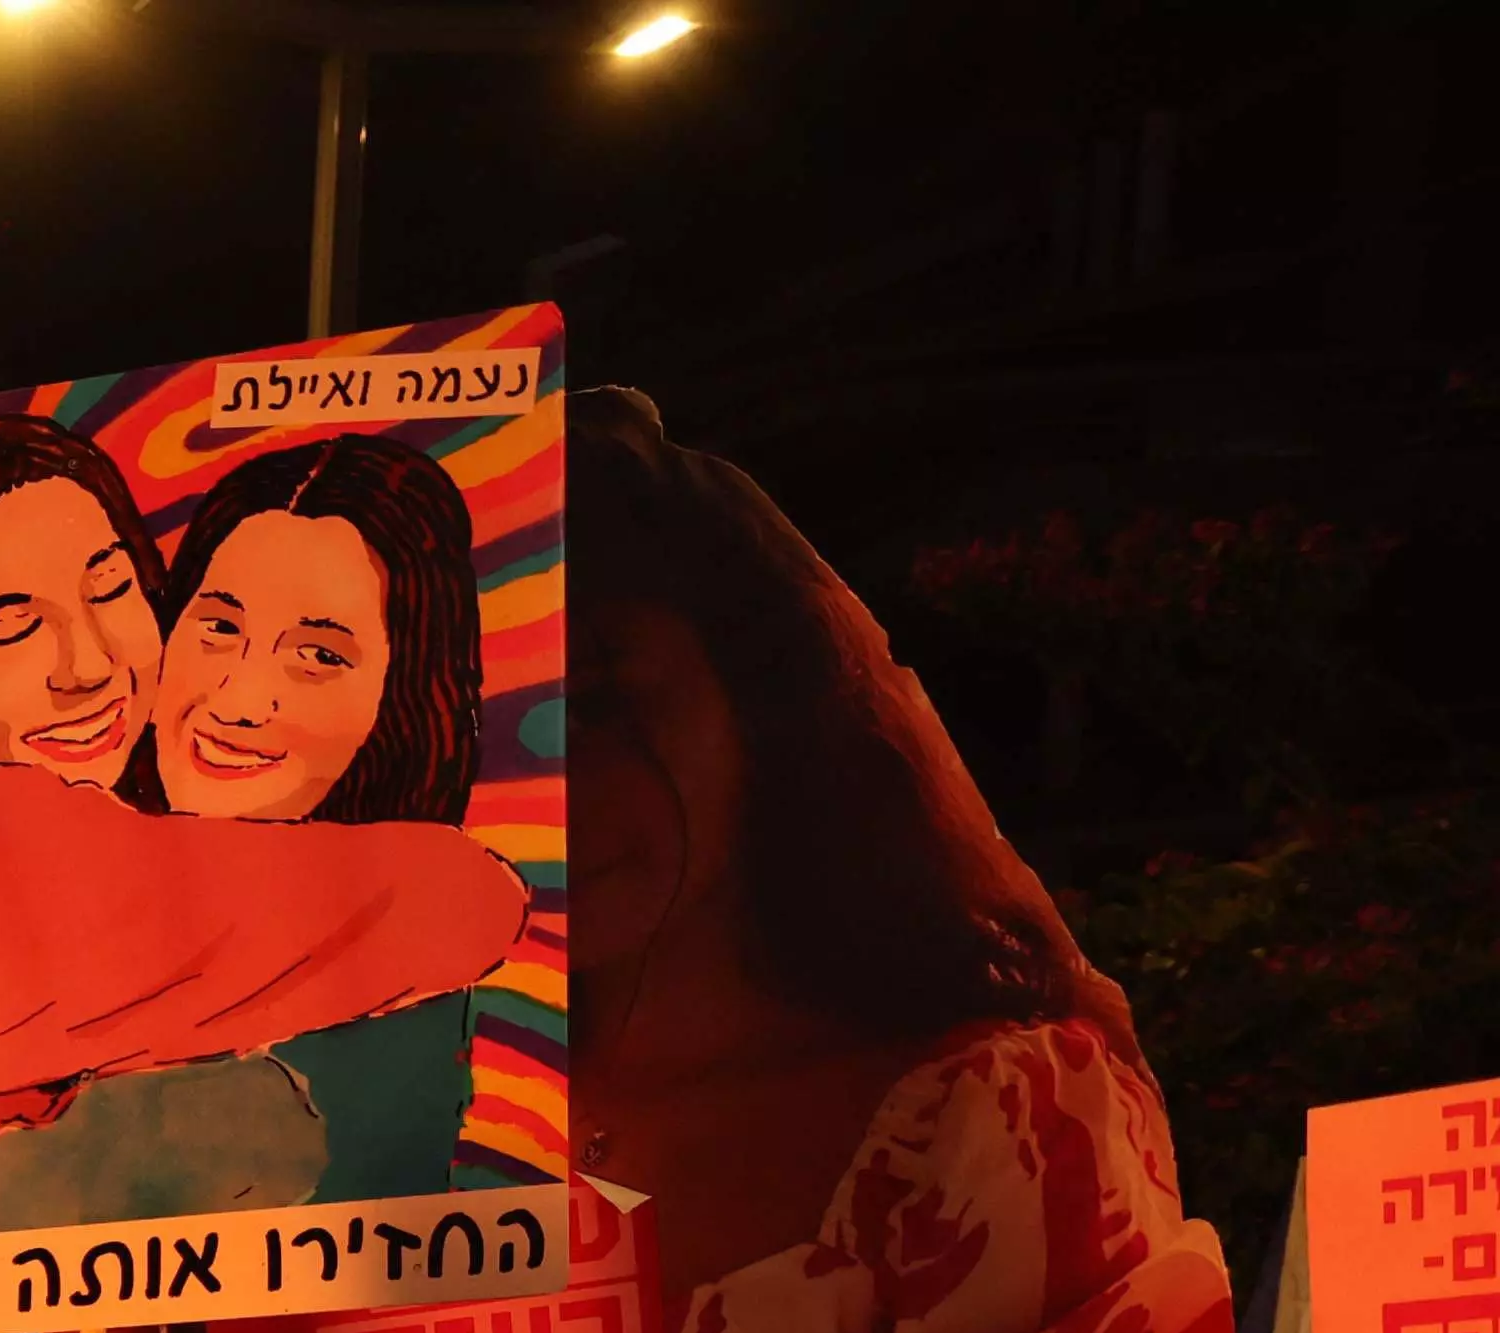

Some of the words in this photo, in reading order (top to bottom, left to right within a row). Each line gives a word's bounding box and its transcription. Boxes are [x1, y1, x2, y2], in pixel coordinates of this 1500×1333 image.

[221, 365, 371, 412] ואיילת
[396, 364, 528, 403] נעמה
[11, 1230, 223, 1307] אותה
[266, 1208, 546, 1290] החזירו
